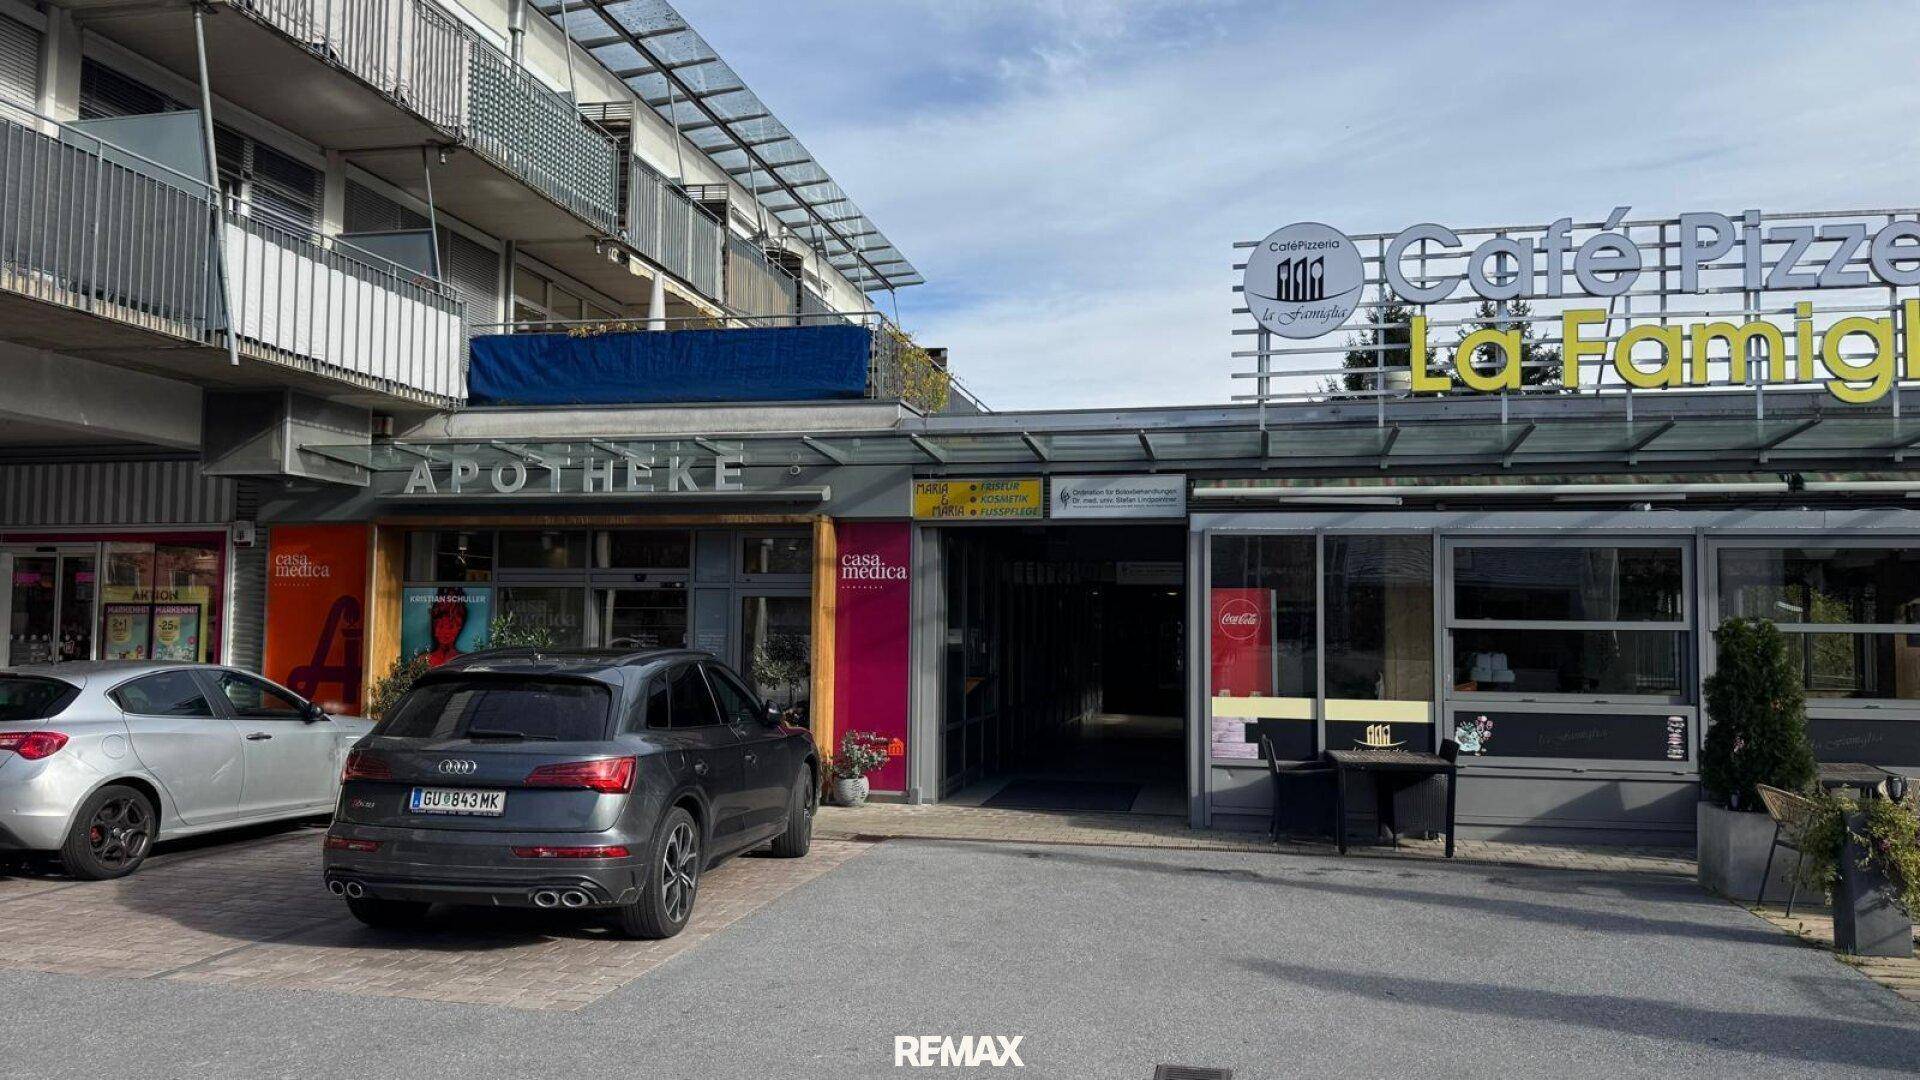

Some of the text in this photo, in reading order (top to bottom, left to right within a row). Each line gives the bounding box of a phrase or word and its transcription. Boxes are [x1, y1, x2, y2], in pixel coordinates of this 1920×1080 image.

[1269, 240, 1340, 252] CaféPizzeria
[1384, 206, 1642, 304] Café
[1262, 305, 1348, 326] la Famiglia
[1410, 315, 1521, 392] La
[403, 454, 745, 494] APOTHEKE
[916, 483, 949, 495] MARIA
[981, 480, 1020, 491] FRISEUR
[981, 494, 1029, 504] KOSMETIK
[932, 505, 966, 517] MARIA
[981, 507, 1039, 517] FUSSPFLEGE
[275, 554, 309, 566] casa
[841, 553, 881, 566] casa
[409, 595, 446, 603] KRISTIAN
[424, 791, 440, 806] GU
